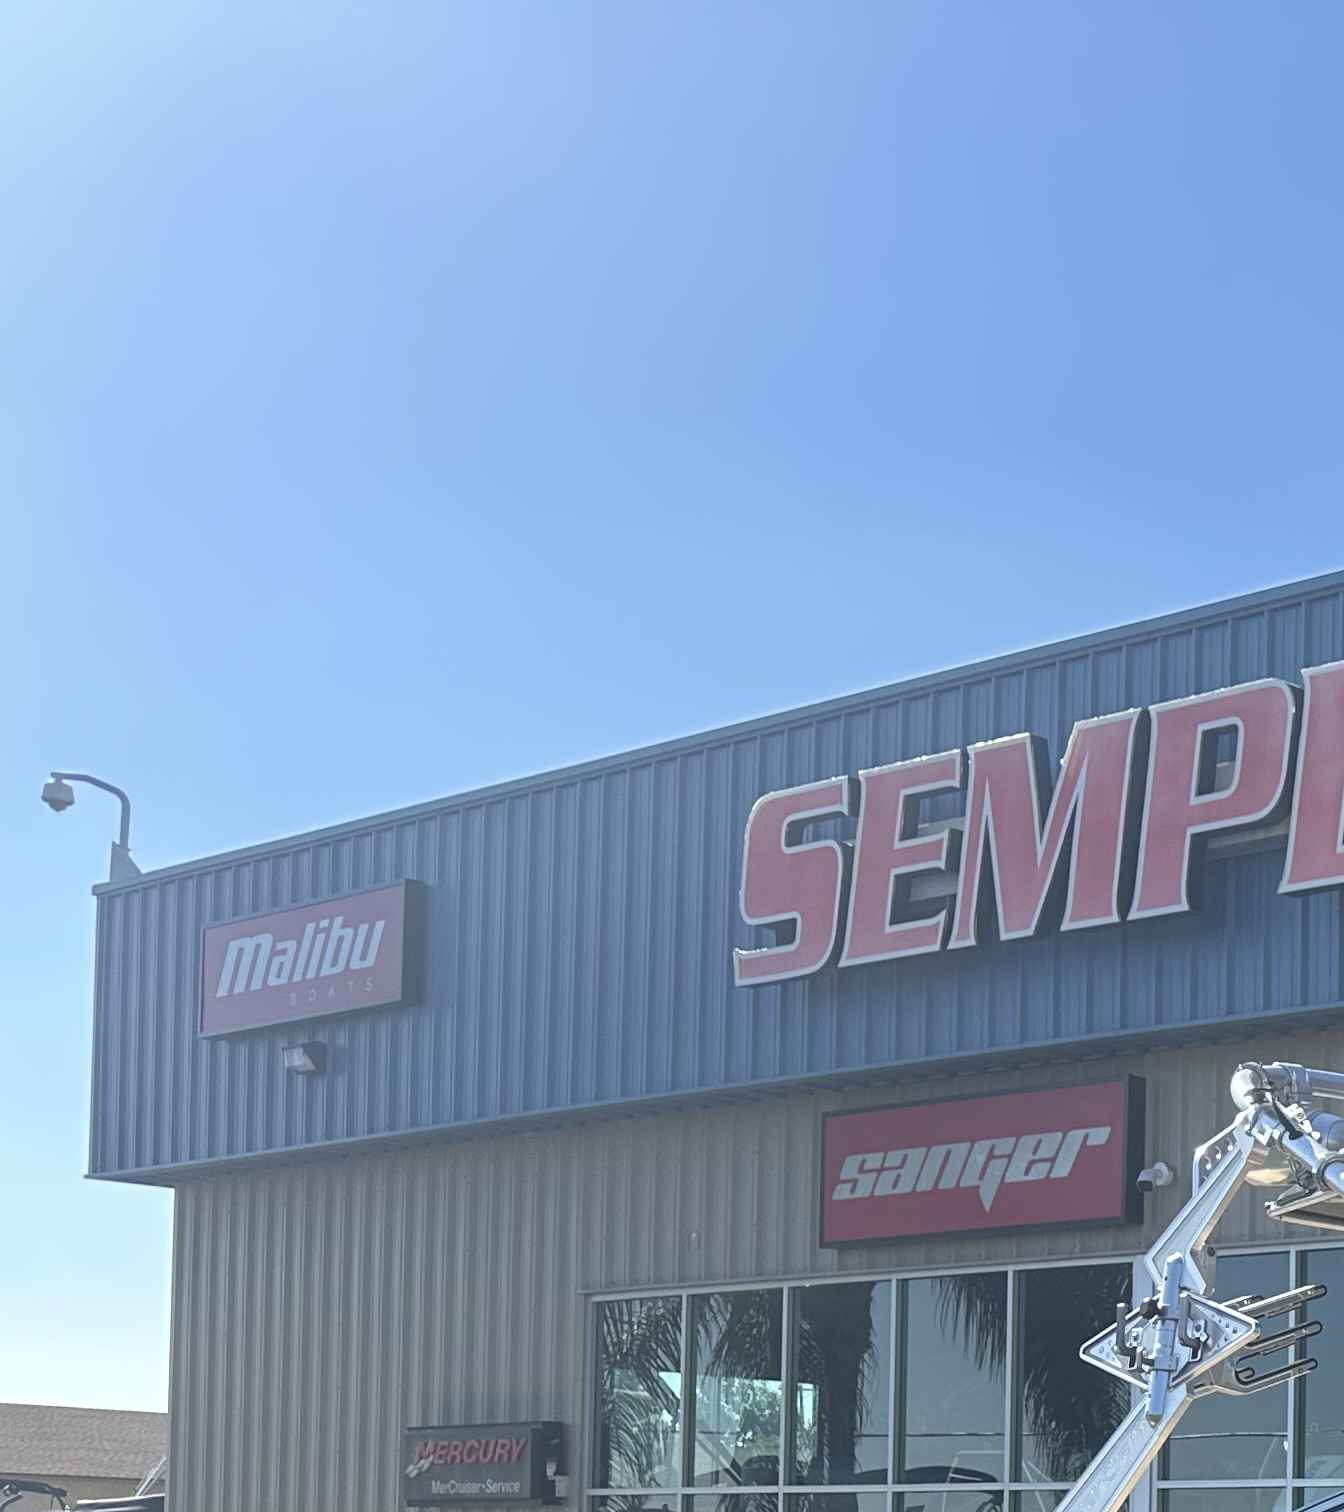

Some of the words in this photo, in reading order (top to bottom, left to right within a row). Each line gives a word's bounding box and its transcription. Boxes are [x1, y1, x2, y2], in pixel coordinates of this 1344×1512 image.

[216, 916, 386, 998] Malibu
[289, 977, 375, 1006] BOATS
[415, 1437, 528, 1464] MERCURY
